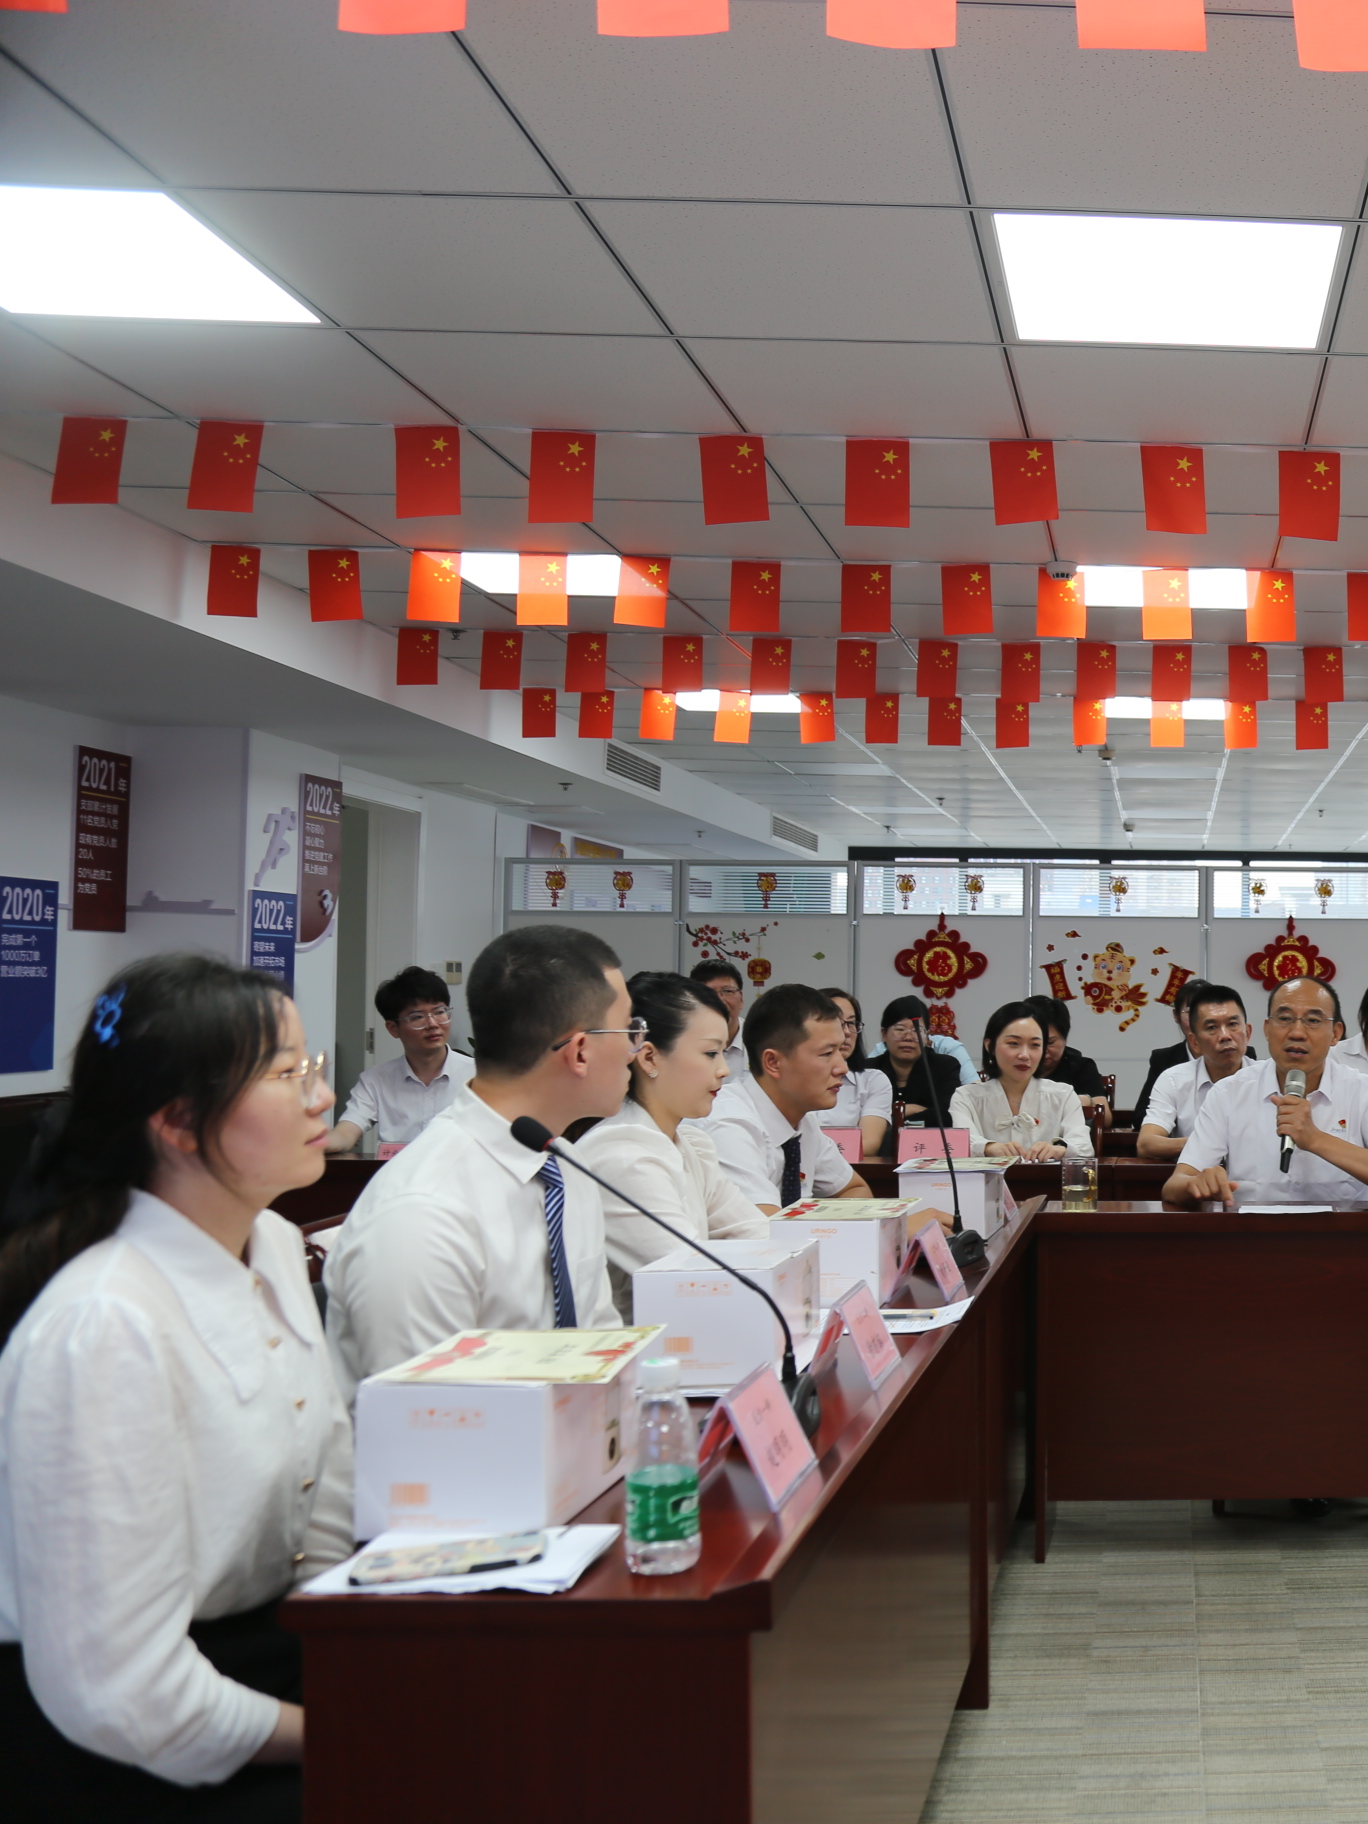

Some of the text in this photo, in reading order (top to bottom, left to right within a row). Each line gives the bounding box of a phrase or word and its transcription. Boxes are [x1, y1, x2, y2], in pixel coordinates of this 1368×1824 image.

[81, 755, 128, 793] 2021年
[306, 782, 340, 816] 2022年
[78, 848, 94, 860] 20人
[2, 886, 55, 922] 2020年
[254, 898, 293, 931] 2022年
[926, 950, 953, 978] 福
